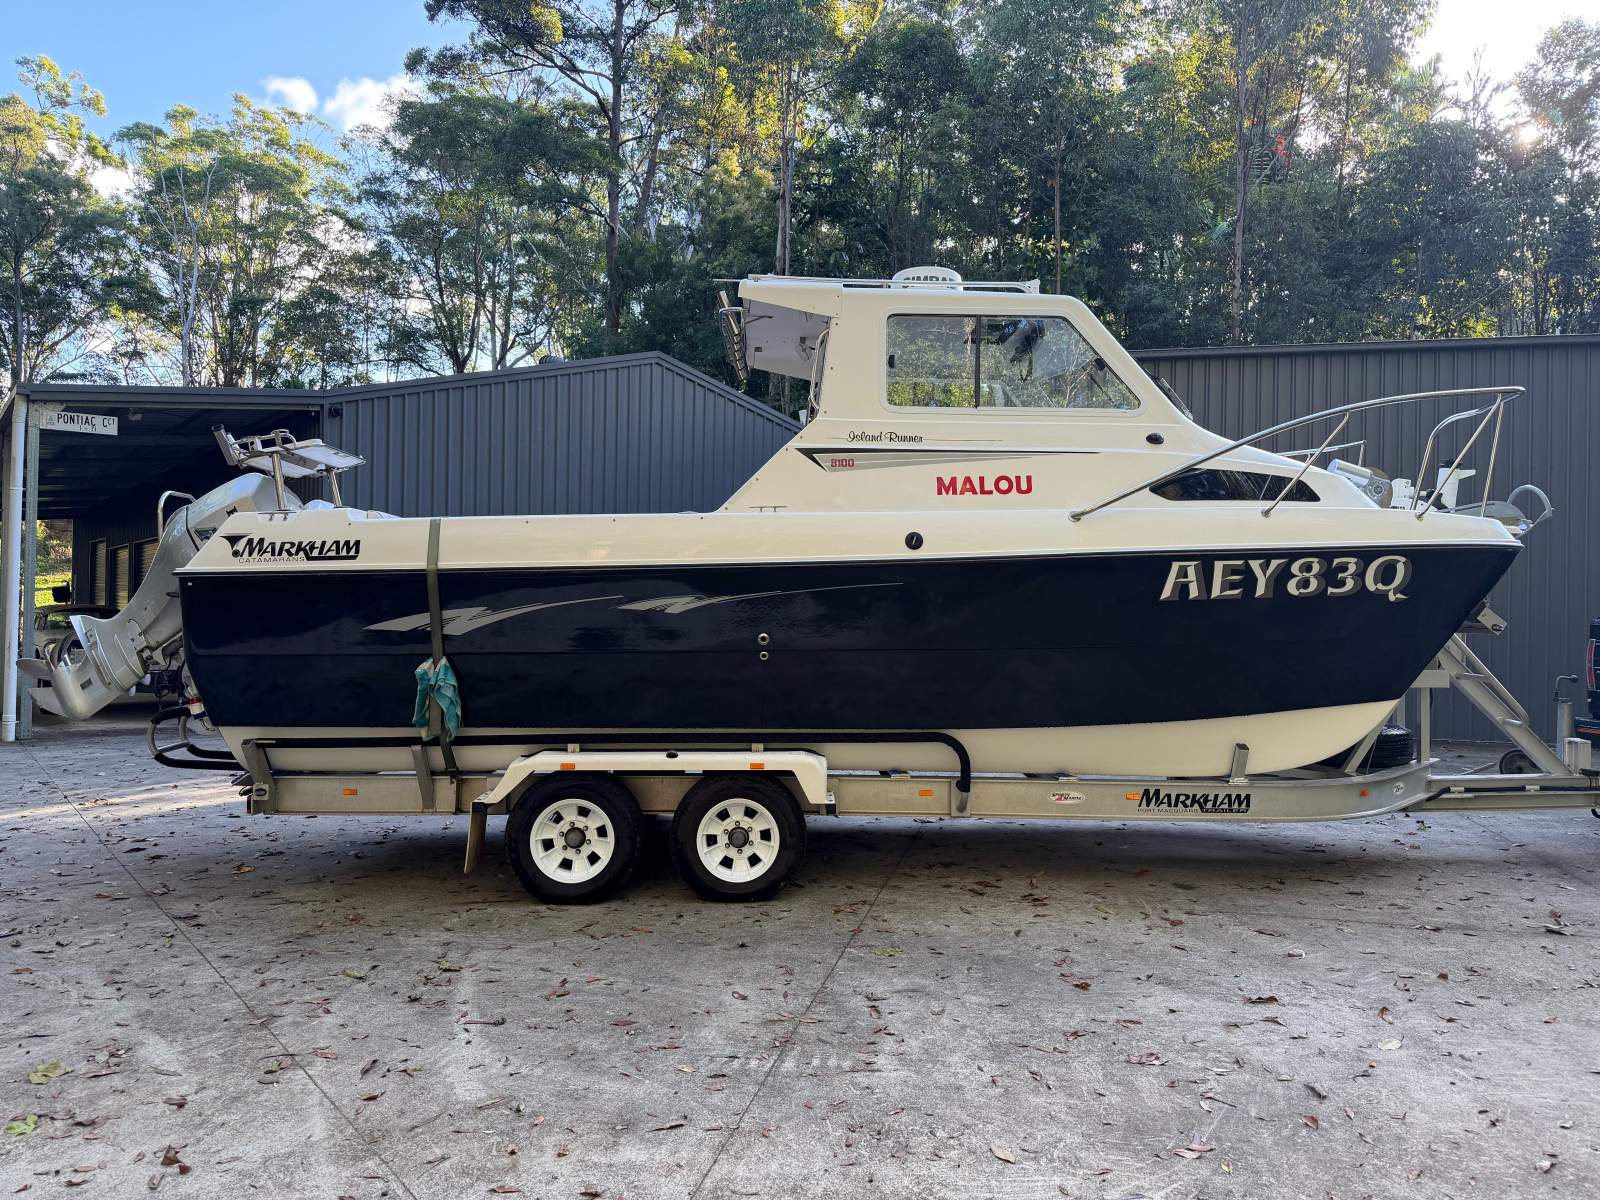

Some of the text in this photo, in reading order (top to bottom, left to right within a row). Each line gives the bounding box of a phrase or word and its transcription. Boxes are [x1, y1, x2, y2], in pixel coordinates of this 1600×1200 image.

[57, 413, 96, 427] PONTIAC
[846, 430, 924, 444] Island Runner
[936, 475, 1033, 496] MALOU
[239, 537, 361, 560] MARKHAM
[1159, 555, 1413, 602] AEY83Q
[1138, 788, 1251, 808] MARKHAM
